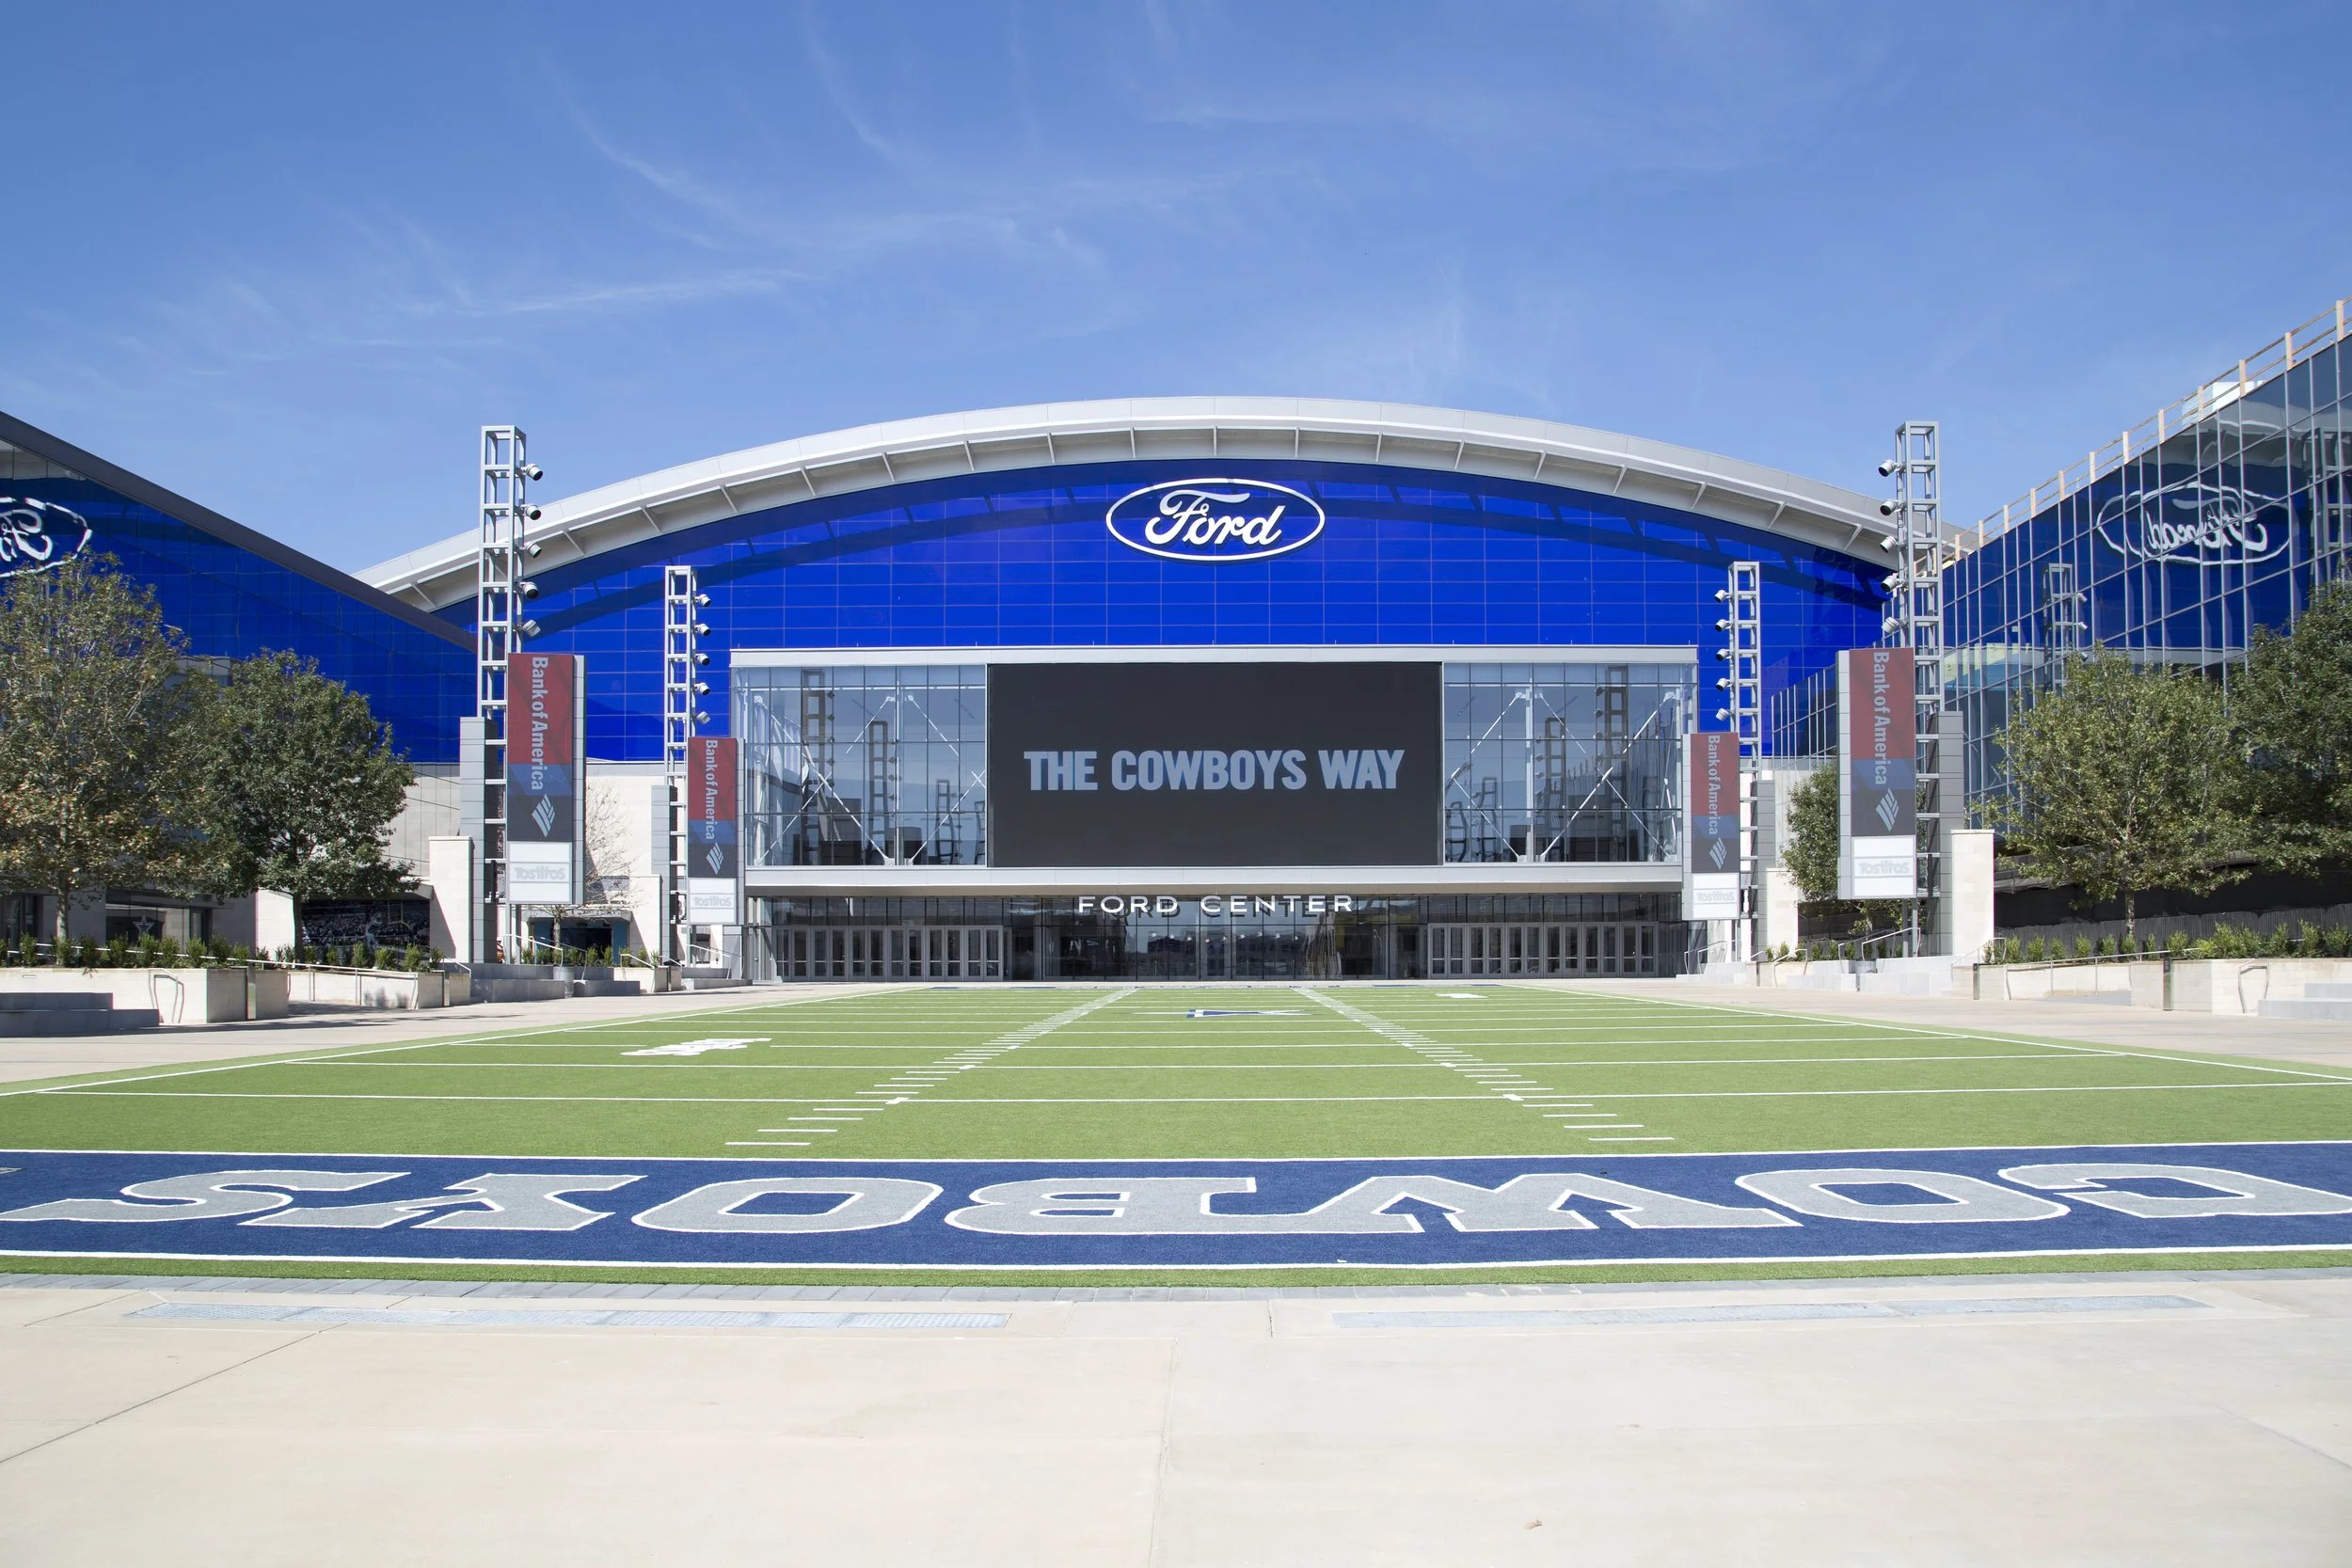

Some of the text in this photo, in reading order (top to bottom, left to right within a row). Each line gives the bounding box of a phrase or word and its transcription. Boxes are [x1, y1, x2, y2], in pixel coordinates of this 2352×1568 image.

[1145, 489, 1286, 546] Ford
[531, 657, 548, 790] Bank of America
[1874, 652, 1891, 785] Bank of America
[706, 739, 719, 840] Bank of America
[1024, 749, 1405, 790] THE COWBOYS WAY
[1708, 736, 1721, 835] Bank of America
[1078, 895, 1353, 913] FORD CENTER
[0, 1163, 2352, 1236] COWBOYS
